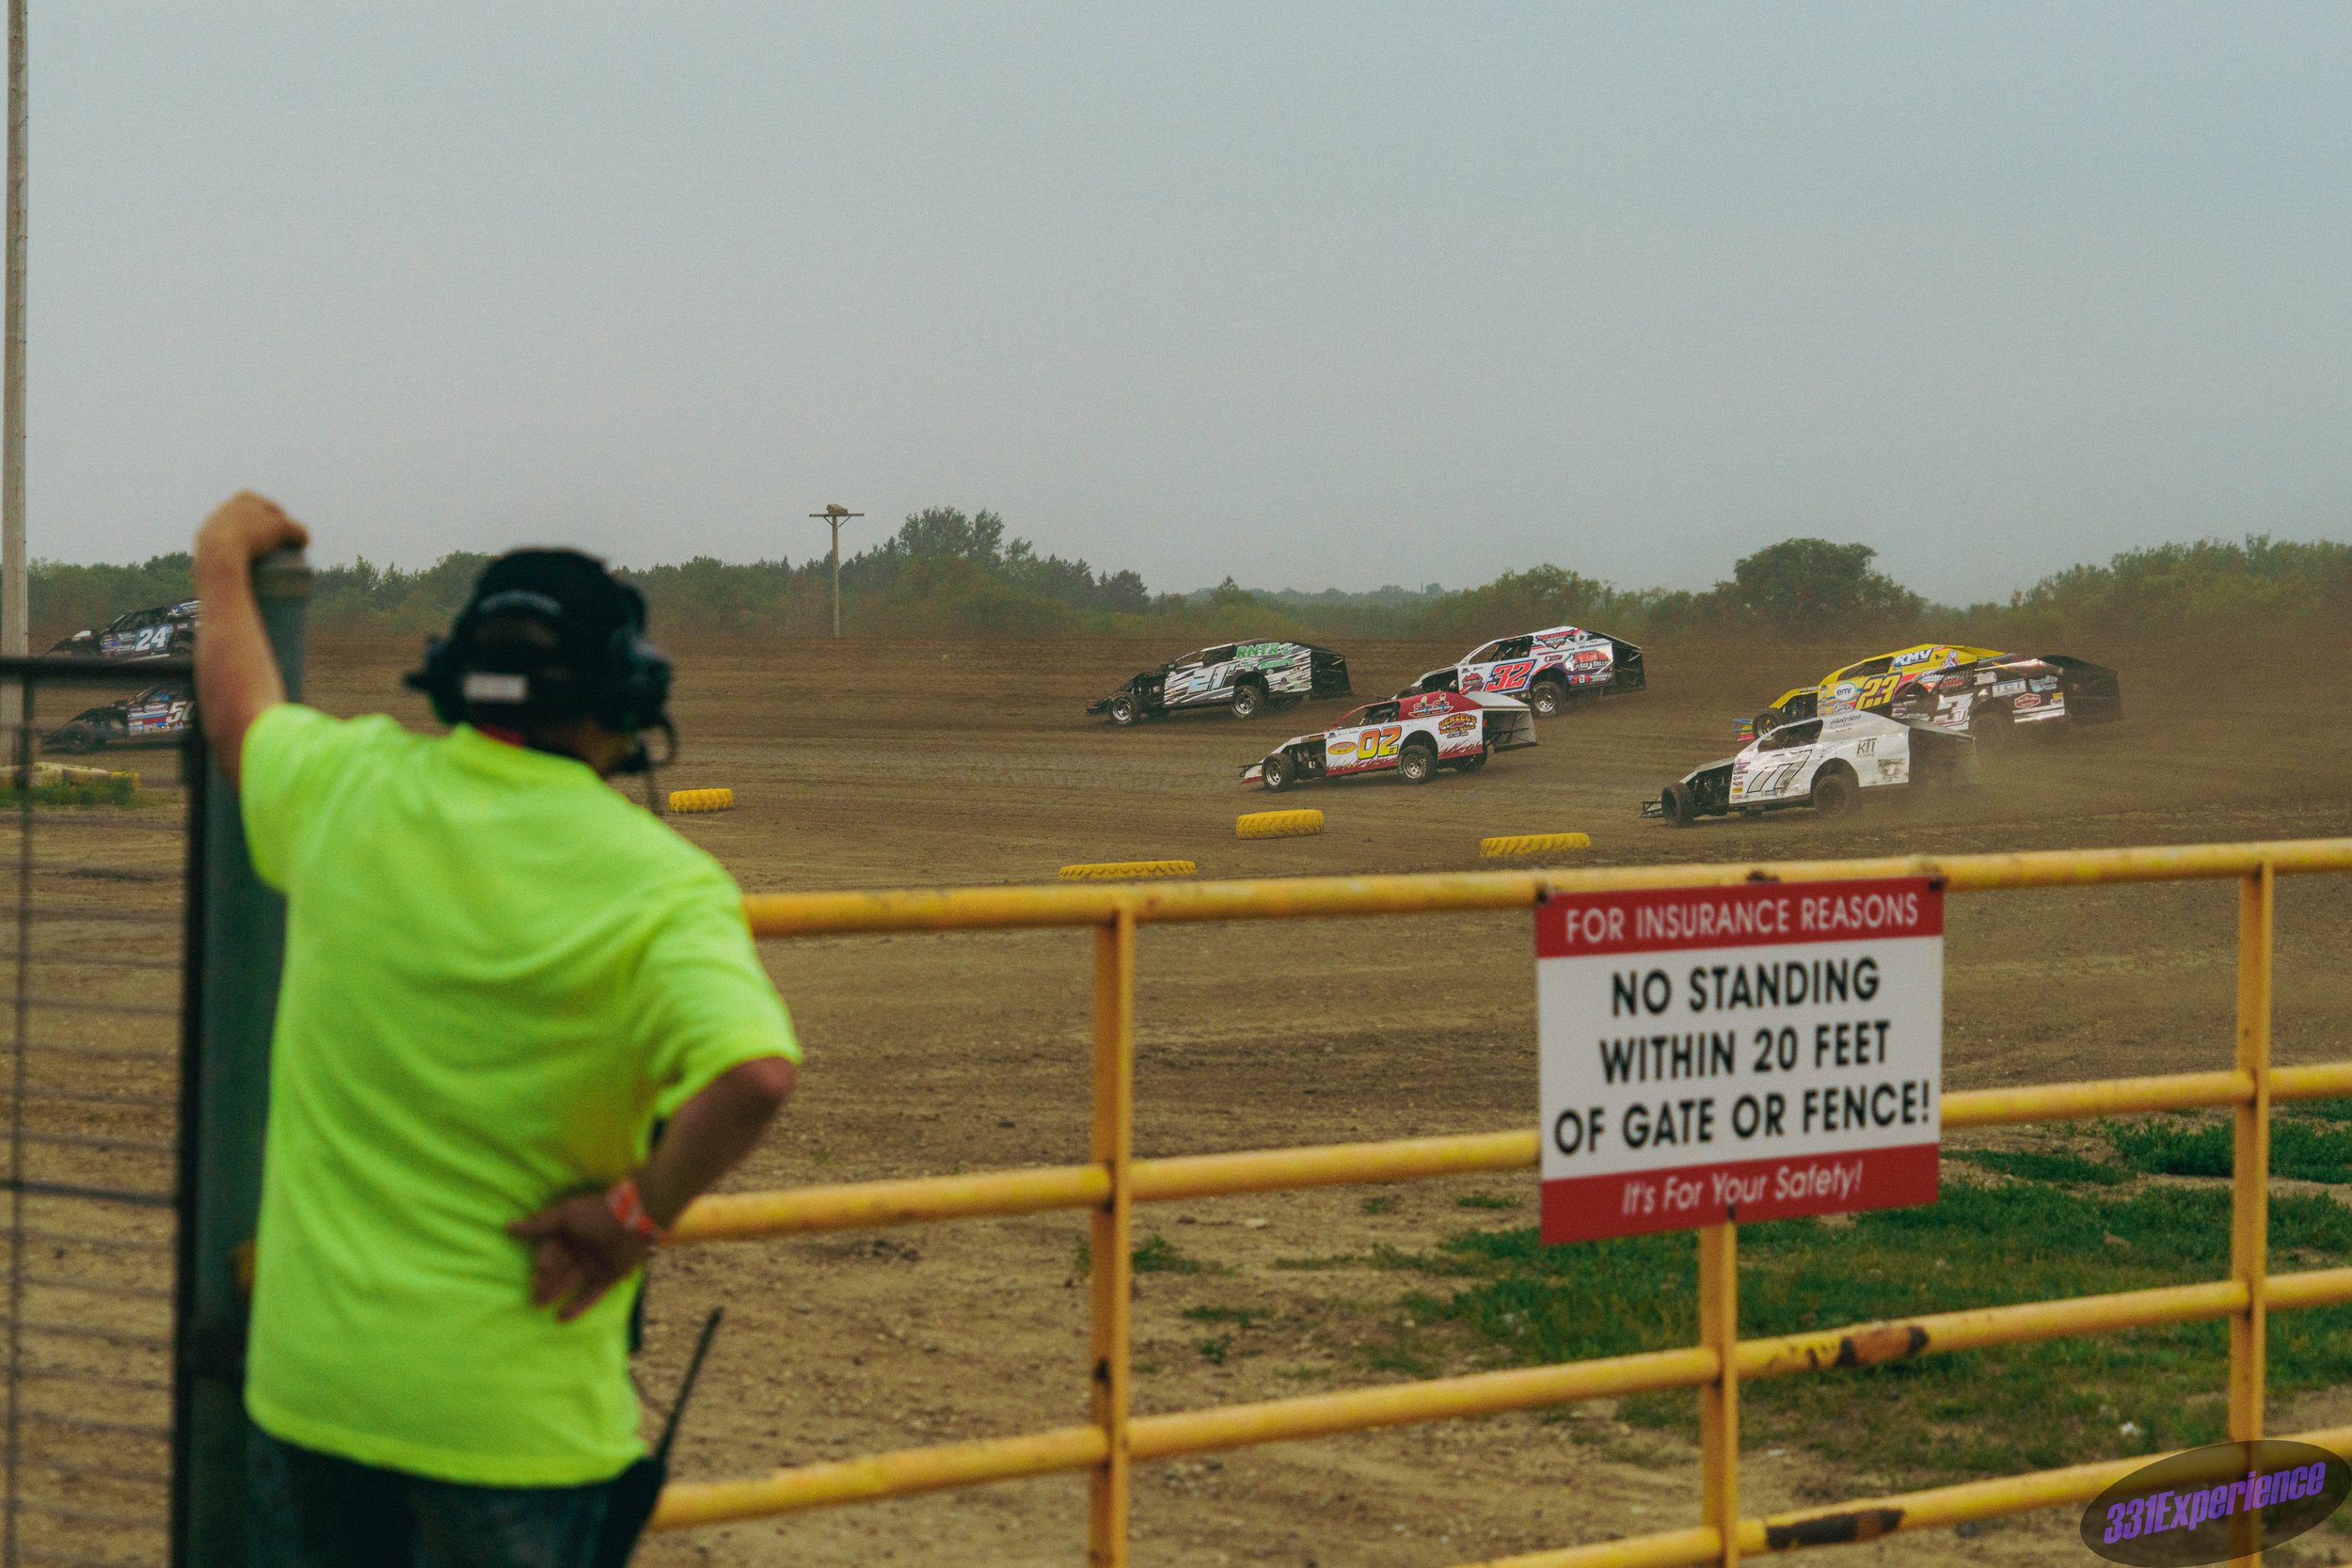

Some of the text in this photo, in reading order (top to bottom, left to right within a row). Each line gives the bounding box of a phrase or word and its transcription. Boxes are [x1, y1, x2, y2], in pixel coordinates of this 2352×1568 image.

[135, 625, 167, 652] 24
[1895, 648, 1933, 666] RMV
[1486, 661, 1534, 692] 32
[1836, 687, 1852, 696] emr
[1855, 674, 1902, 710] 23
[1438, 712, 1478, 731] DENZEL'S
[1830, 714, 1862, 725] Nutrien
[1357, 725, 1402, 760] 02
[1565, 893, 1919, 943] FOR INSURANCE REASONS
[1612, 956, 1881, 1018] NO STANDING
[1600, 1020, 1891, 1085] WITHIN 20 FEET
[1554, 1080, 1931, 1154] OF GATE OR FENCE!
[1621, 1158, 1864, 1215] It's For Your Safety!
